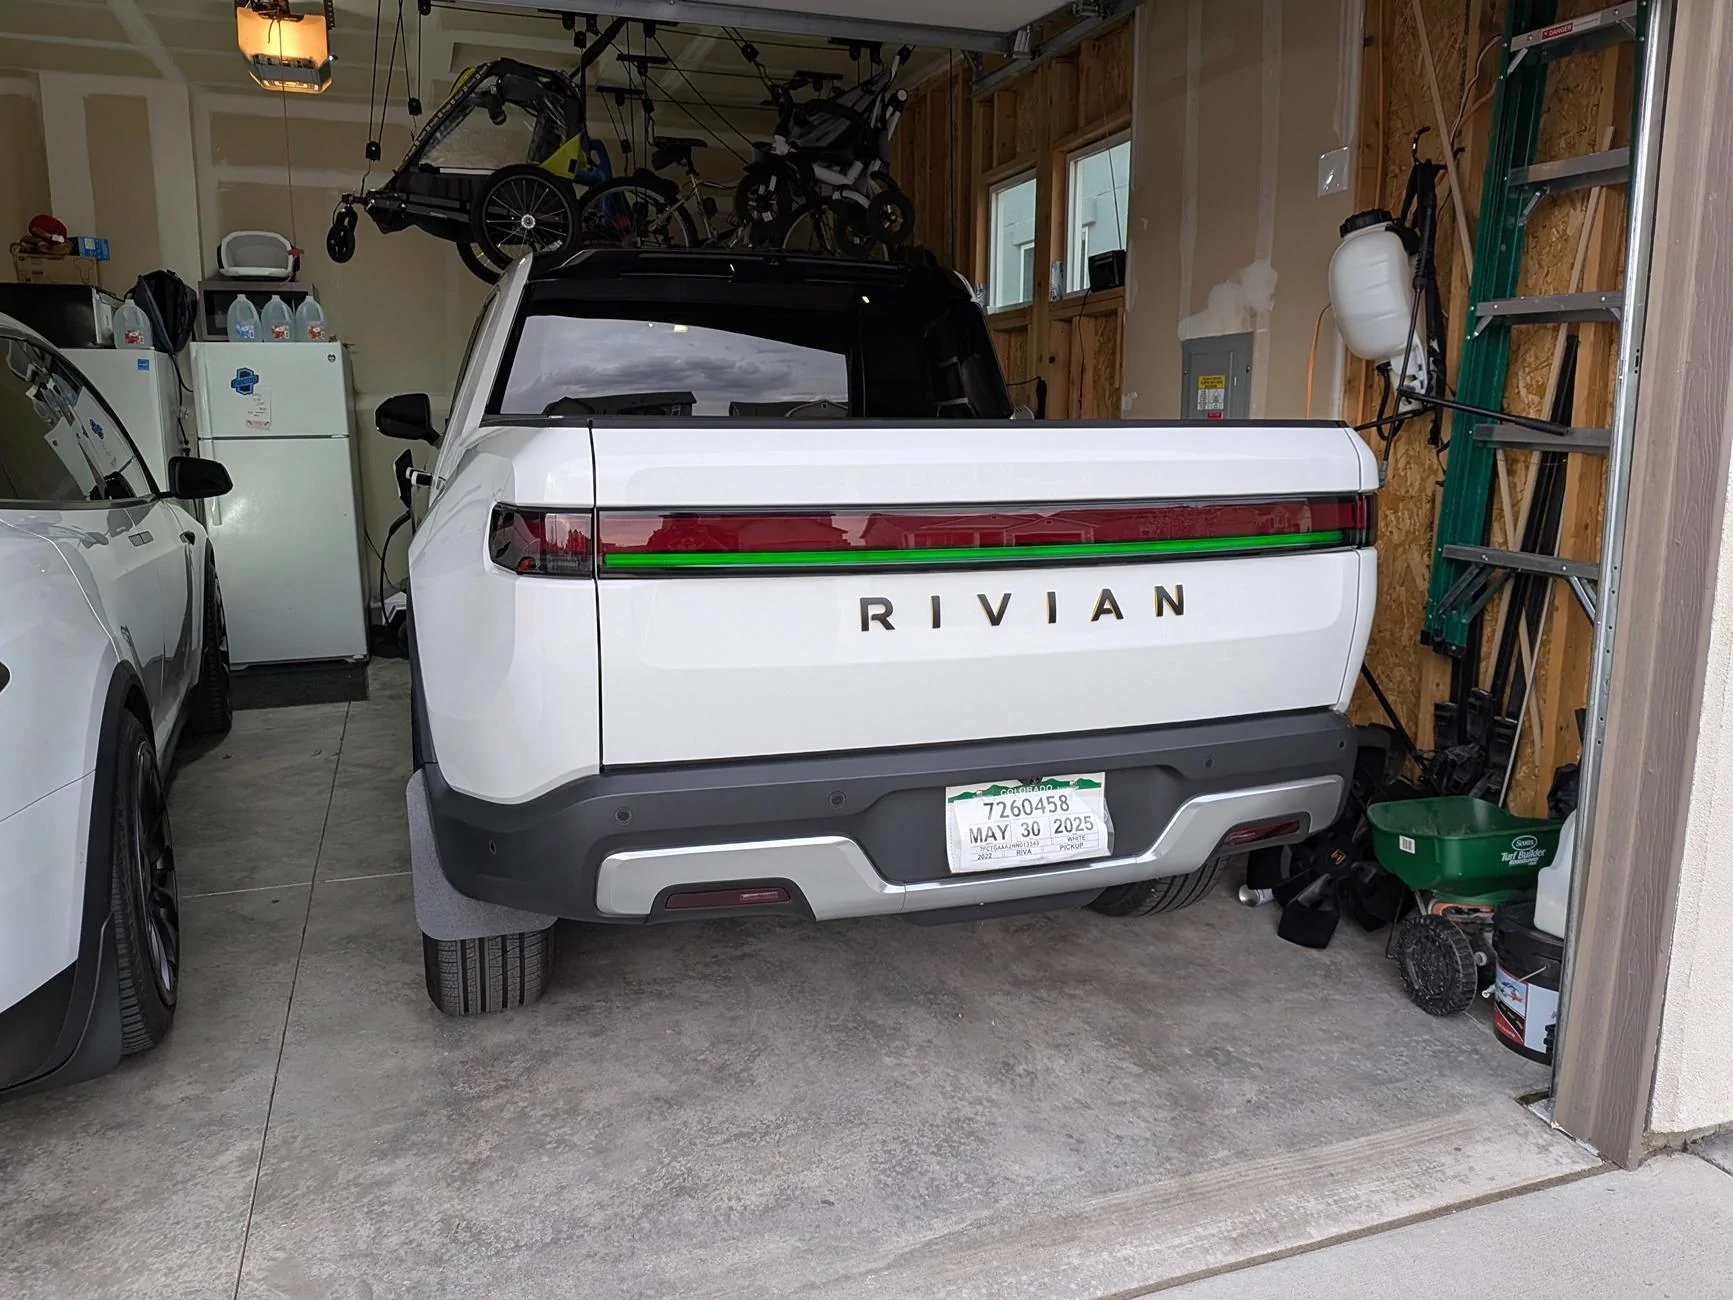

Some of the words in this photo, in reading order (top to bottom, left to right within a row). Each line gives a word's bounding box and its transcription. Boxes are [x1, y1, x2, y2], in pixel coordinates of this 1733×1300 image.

[859, 584, 1185, 632] RIVIAN
[1000, 784, 1053, 796] COLORADO
[983, 794, 1070, 820] 7260458
[969, 824, 1009, 844] MAY
[1021, 821, 1041, 838] 30
[1053, 816, 1094, 835] 2025
[1060, 842, 1084, 851] PICKUP
[1501, 851, 1518, 861] Turf
[1518, 849, 1546, 859] Builder
